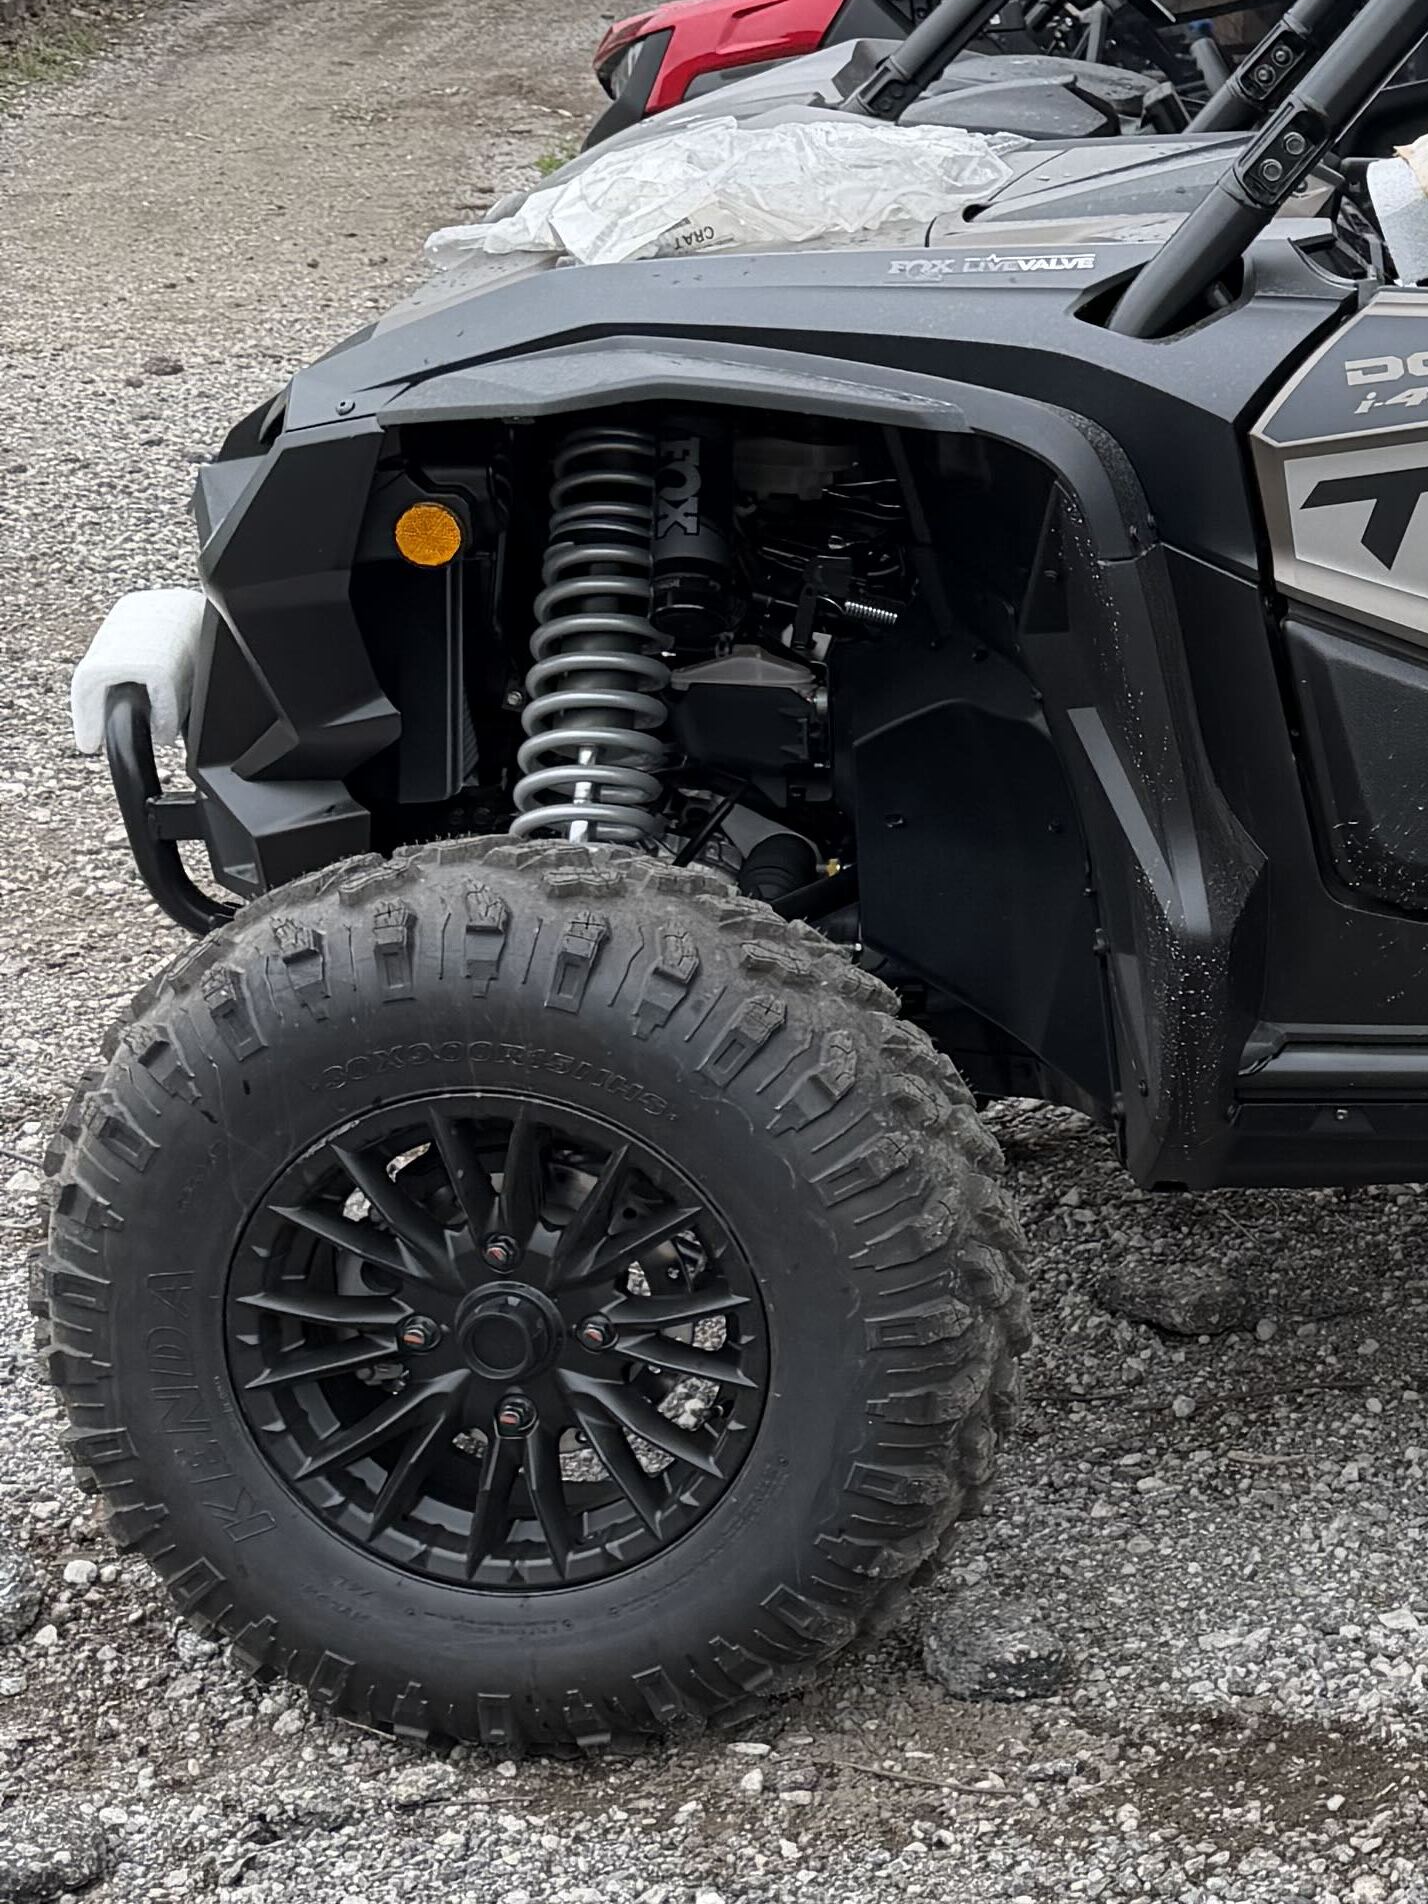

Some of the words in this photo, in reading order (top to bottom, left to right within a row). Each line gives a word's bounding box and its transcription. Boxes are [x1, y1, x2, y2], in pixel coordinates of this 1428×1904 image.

[887, 258, 956, 282] FOX
[656, 435, 702, 539] FOX
[146, 1269, 278, 1544] KENDA
